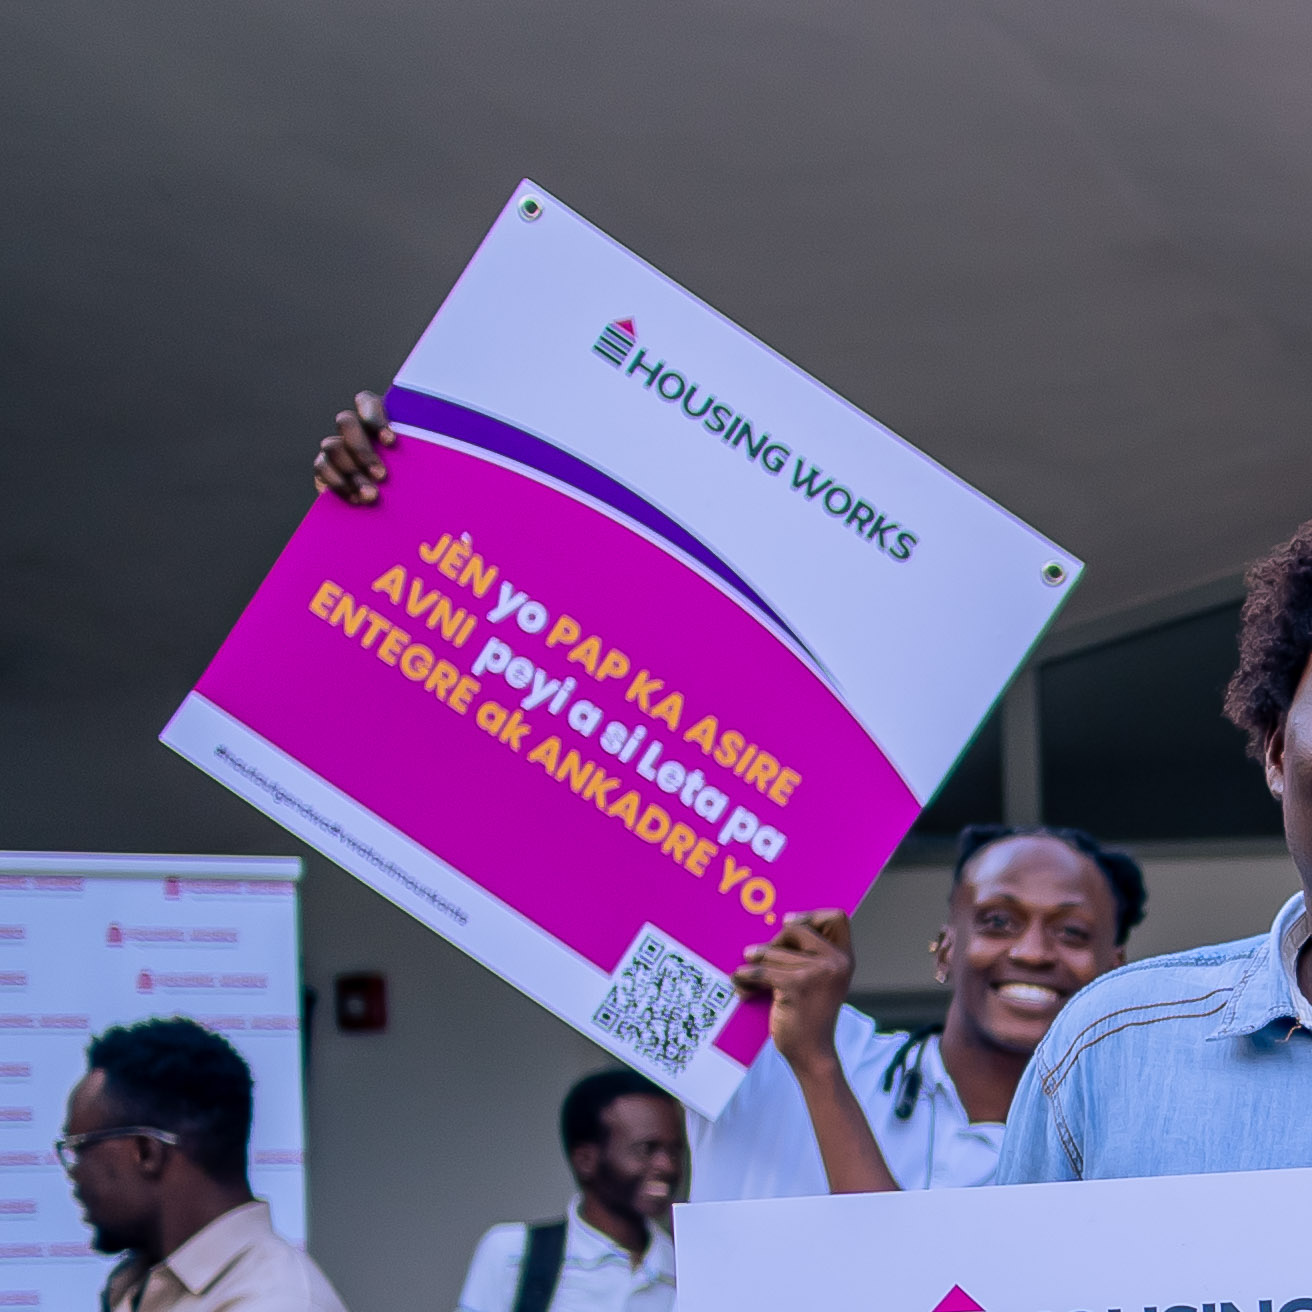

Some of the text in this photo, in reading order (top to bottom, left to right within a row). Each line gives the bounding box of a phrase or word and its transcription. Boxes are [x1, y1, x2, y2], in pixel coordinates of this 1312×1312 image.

[624, 345, 919, 561] HOUSING WORKS
[309, 580, 778, 927] ENTEGRE ak ANKADRE YO.
[374, 568, 785, 862] AVNI peyi a si Leta pa
[418, 532, 800, 805] JÈN yo PAP KA ASIRE
